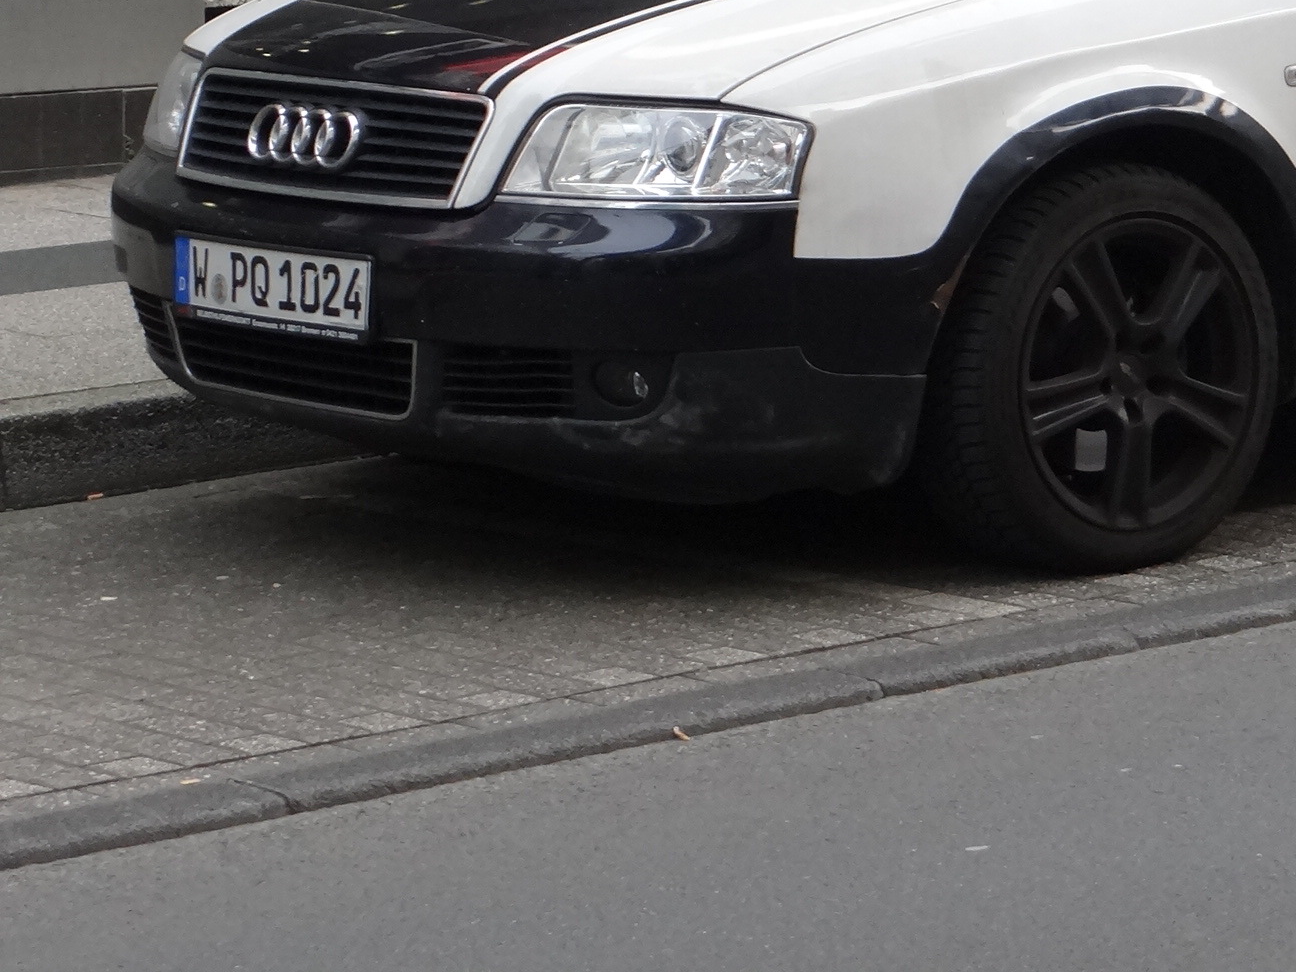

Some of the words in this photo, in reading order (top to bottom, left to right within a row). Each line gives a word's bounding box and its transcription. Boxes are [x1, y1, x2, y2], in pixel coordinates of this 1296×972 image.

[193, 245, 209, 297] W
[230, 252, 269, 307] PQ
[279, 259, 361, 319] 1024
